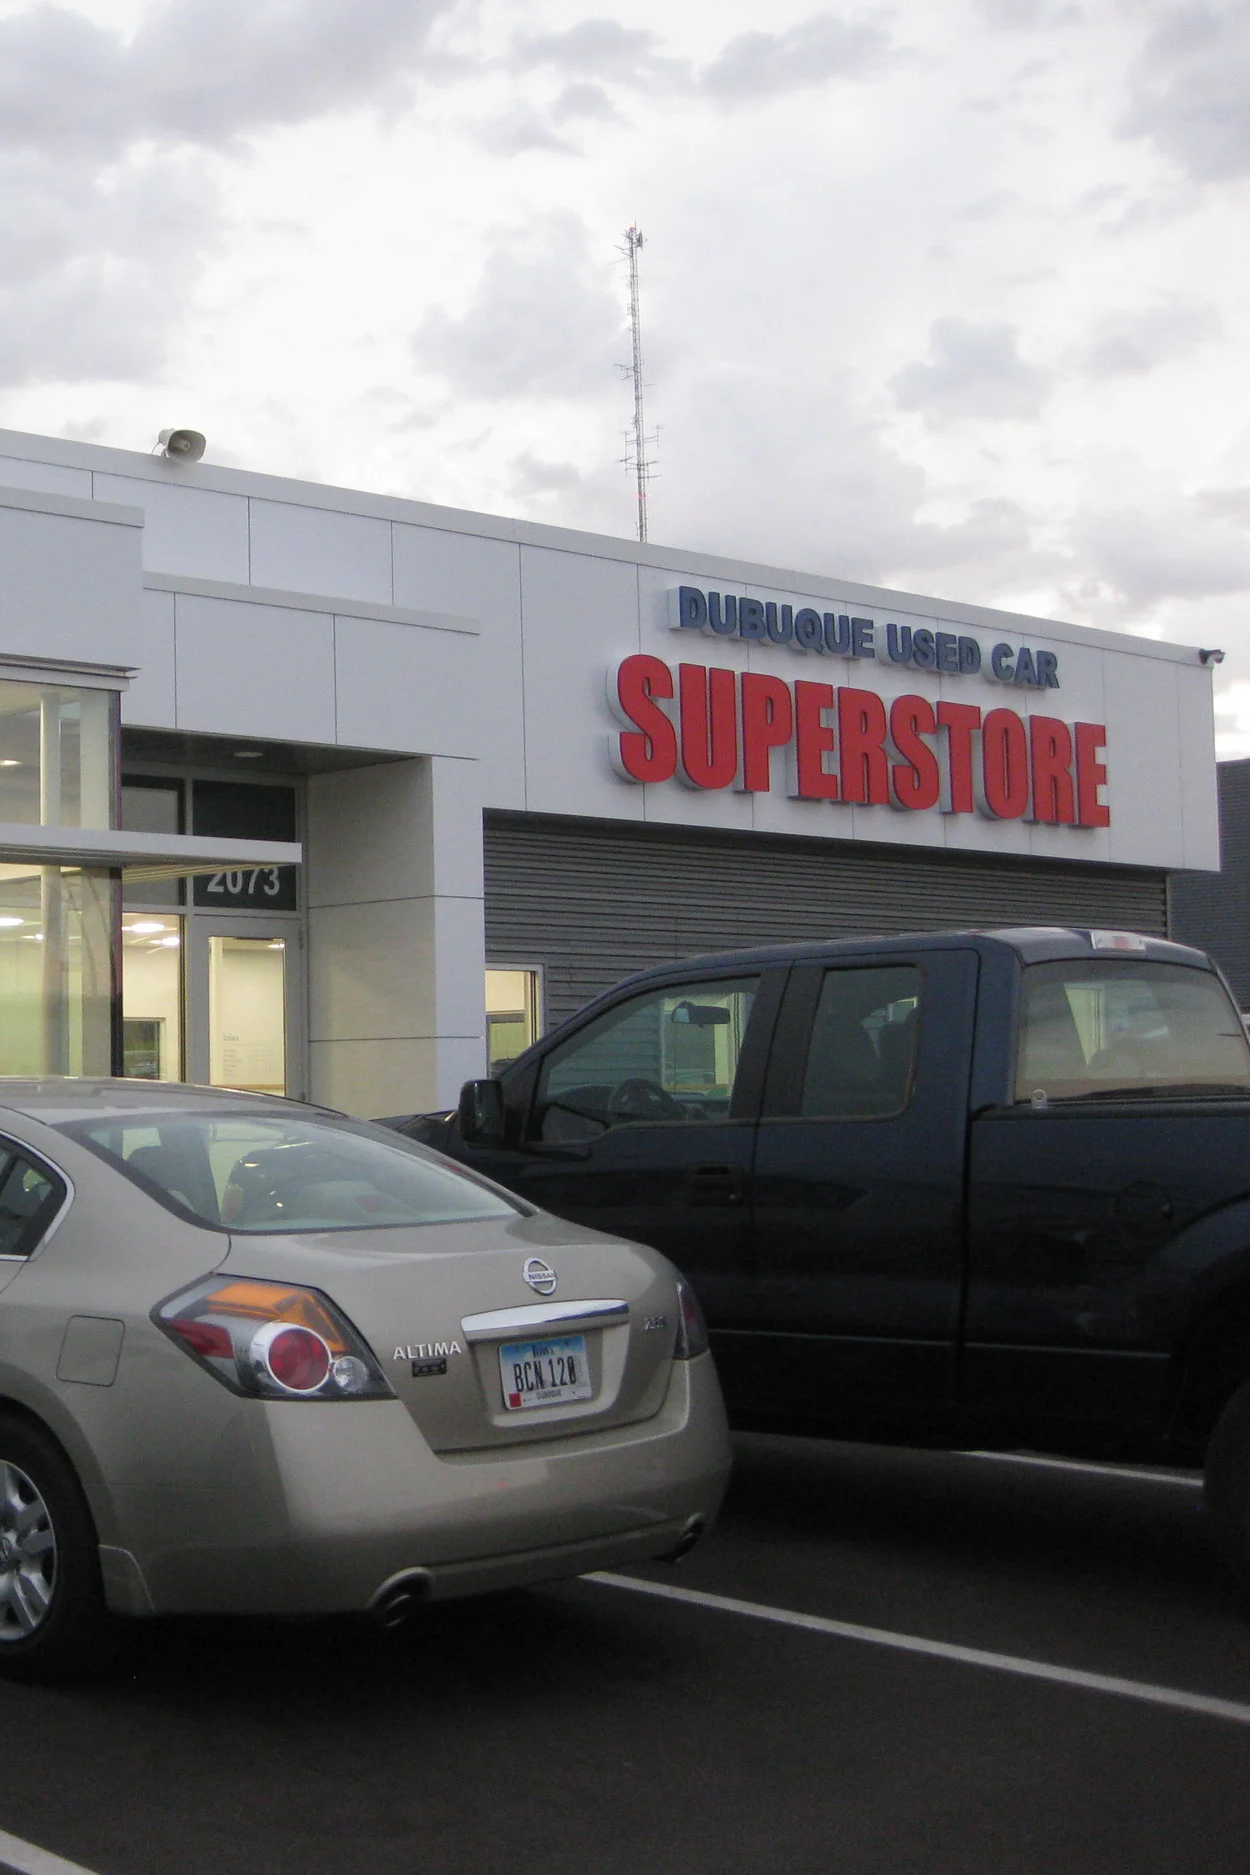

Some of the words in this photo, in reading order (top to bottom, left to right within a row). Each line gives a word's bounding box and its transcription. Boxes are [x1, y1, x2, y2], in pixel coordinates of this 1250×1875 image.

[678, 585, 875, 658] DUBUQUE
[886, 622, 982, 675] USED
[991, 643, 1060, 689] CAR
[617, 654, 1111, 827] SUPERSTORE
[207, 865, 281, 896] 2073
[392, 1340, 462, 1360] ALTIMA
[513, 1360, 545, 1393] BCN
[548, 1355, 577, 1388] 120
